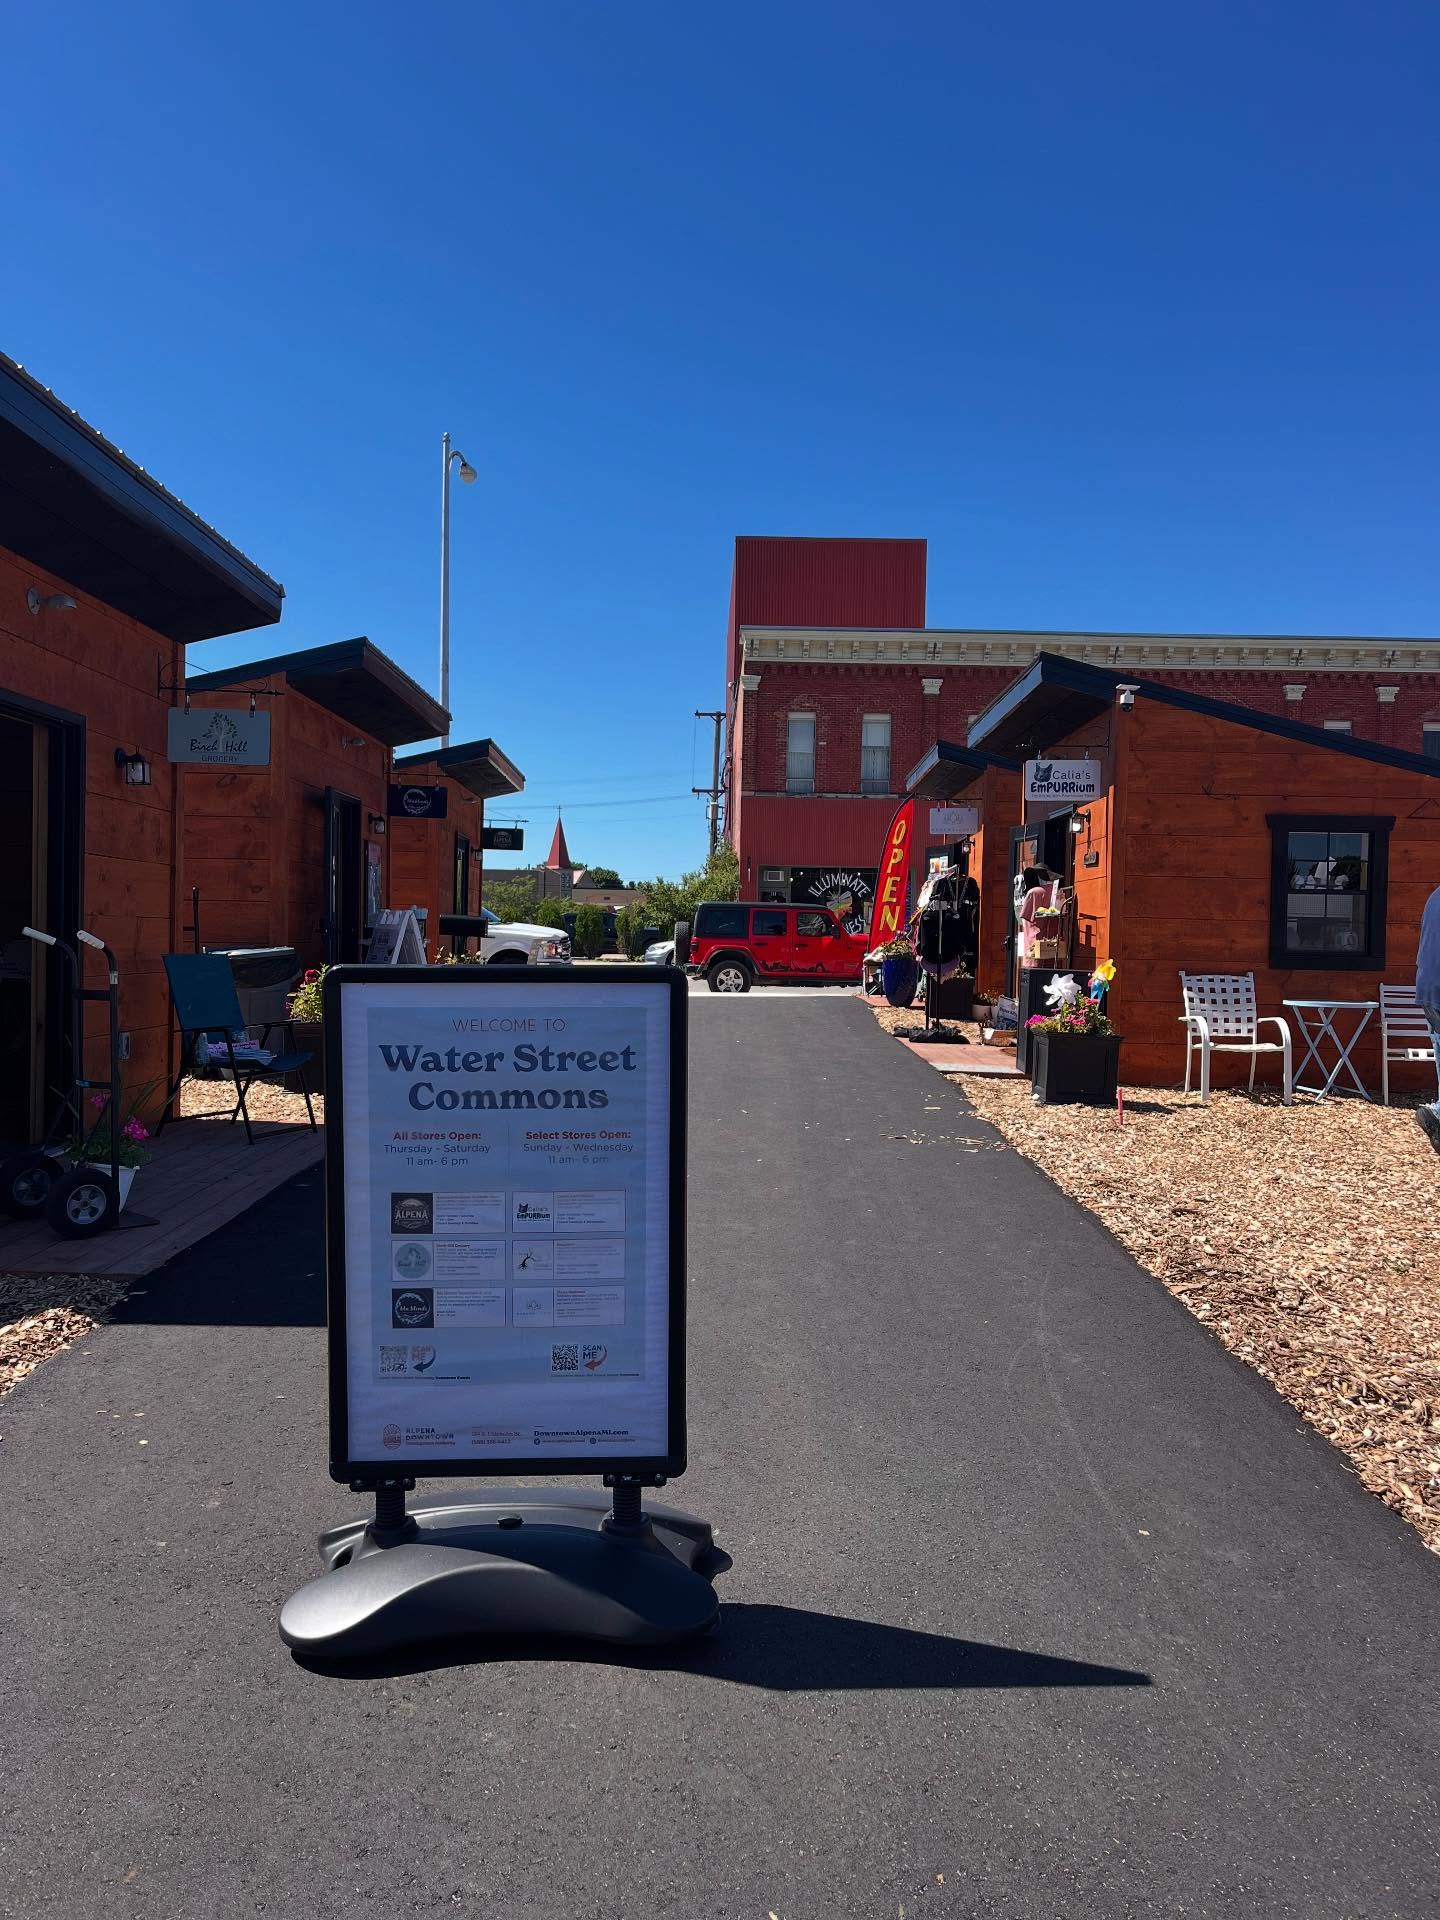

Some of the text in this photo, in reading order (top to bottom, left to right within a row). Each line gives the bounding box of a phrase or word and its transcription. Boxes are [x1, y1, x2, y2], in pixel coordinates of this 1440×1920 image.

[190, 738, 248, 752] Birch Hill
[201, 754, 238, 763] GROCERY
[1052, 770, 1091, 780] Calia's
[1030, 781, 1095, 793] EmPURRium
[879, 819, 907, 932] OPEN
[808, 872, 872, 898] ILLUMINATE
[452, 1018, 567, 1032] WELCOME TO
[378, 1043, 638, 1073] Water Street
[408, 1082, 609, 1111] Commons
[393, 1131, 482, 1141] All Stores Open:
[525, 1130, 632, 1140] Select Stores Open:
[384, 1144, 433, 1154] Thursday
[443, 1144, 491, 1154] Saturday
[523, 1143, 562, 1153] Sunday
[573, 1143, 634, 1153] Wednesday
[406, 1157, 414, 1166] 11
[441, 1157, 448, 1166] 6
[451, 1158, 469, 1168] pm
[548, 1156, 555, 1165] 11
[592, 1156, 609, 1165] pm
[395, 1210, 428, 1220] ALPENA
[412, 1345, 432, 1353] SCAN
[583, 1344, 602, 1352] SCAN
[412, 1353, 426, 1361] ME
[583, 1352, 598, 1360] ME
